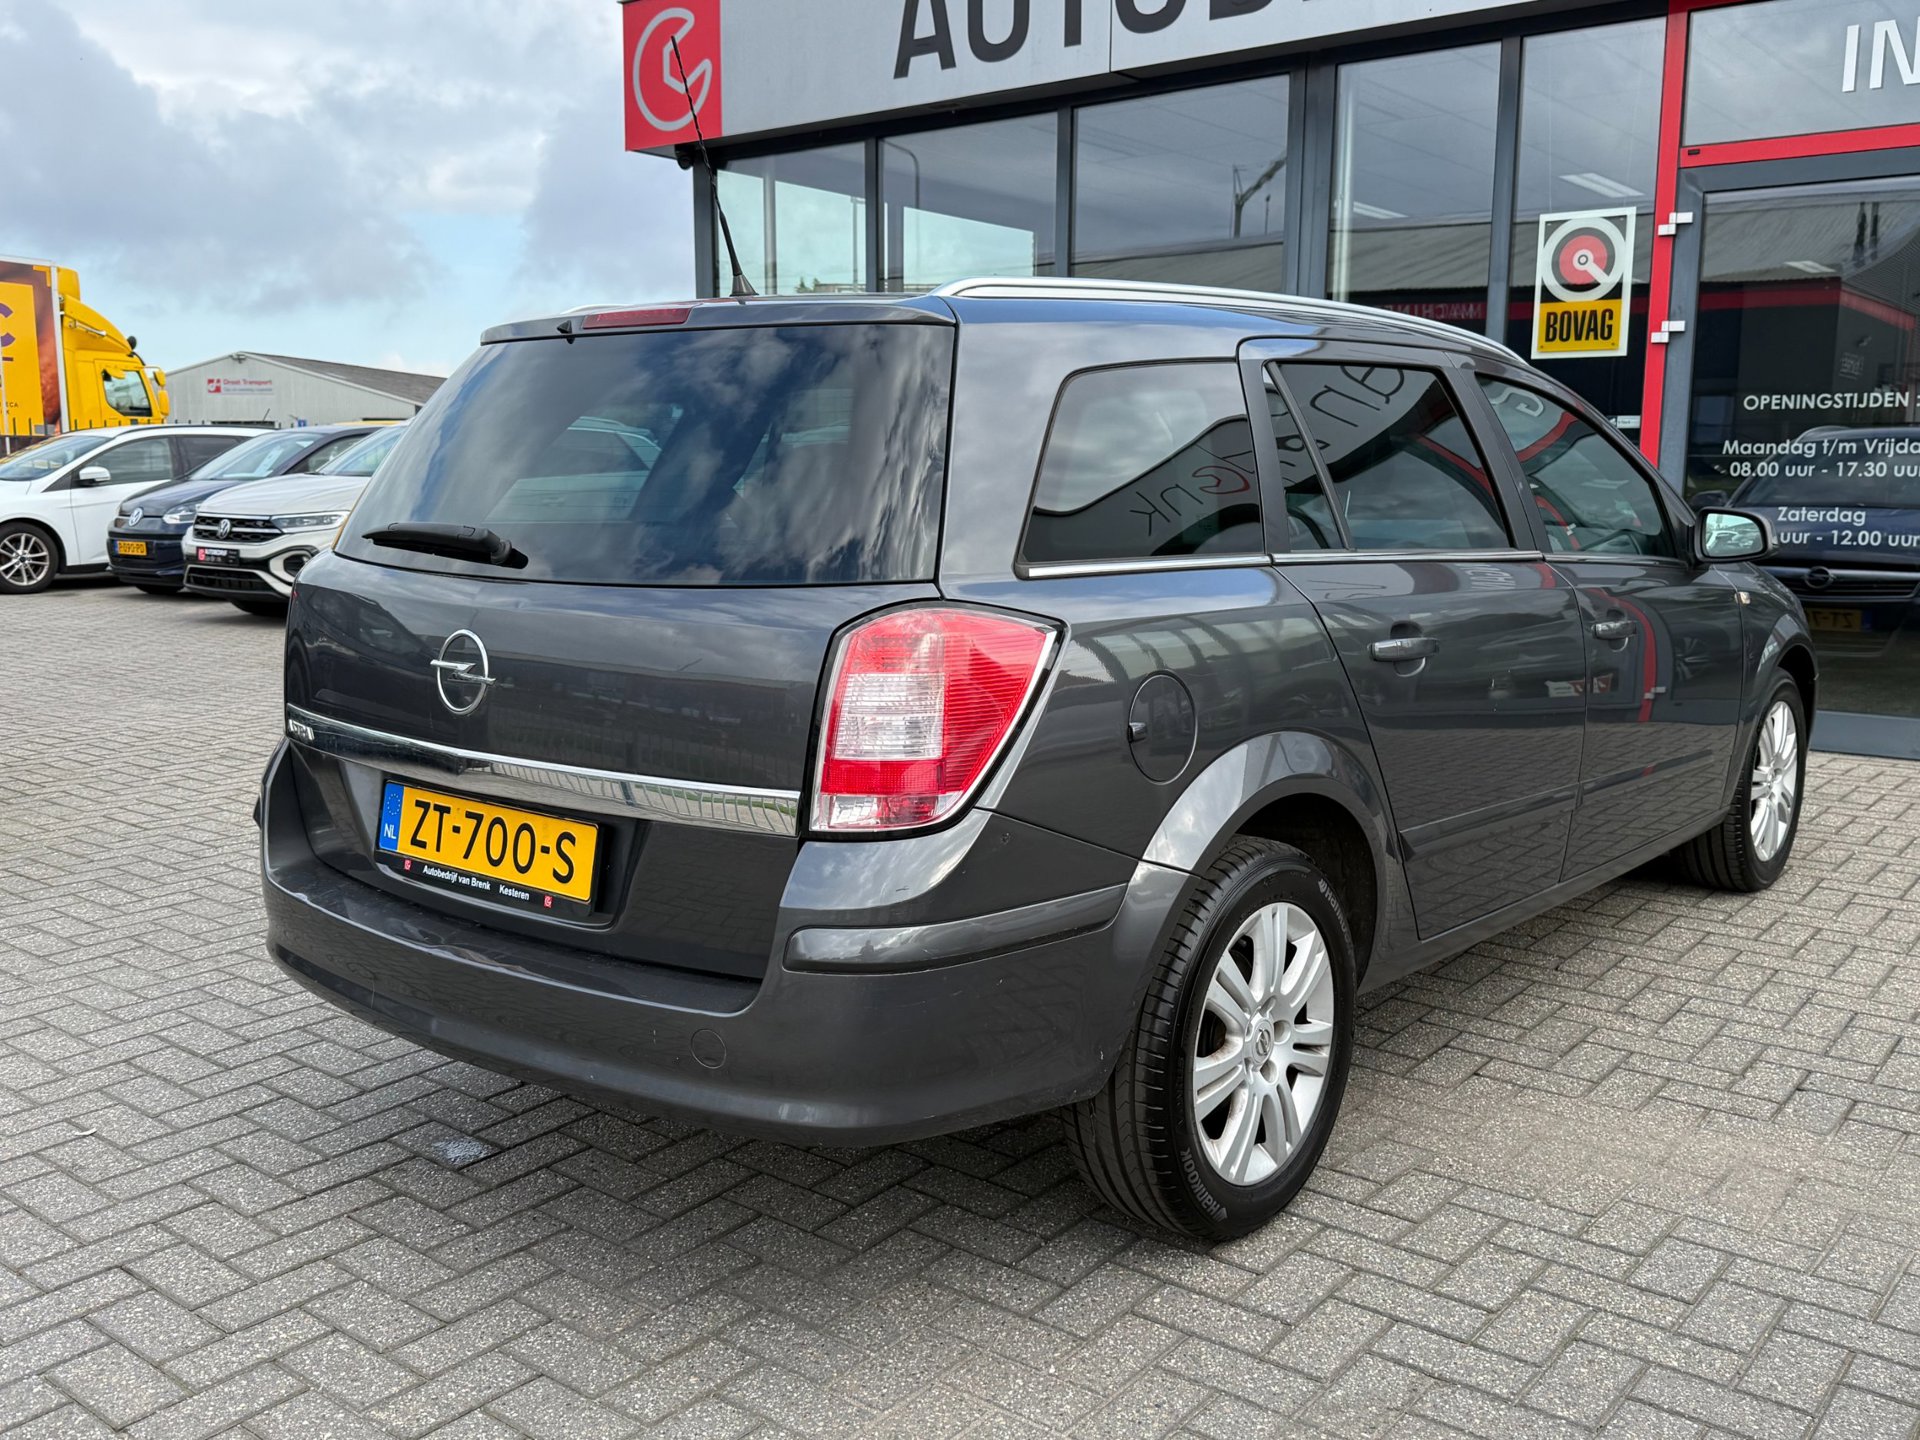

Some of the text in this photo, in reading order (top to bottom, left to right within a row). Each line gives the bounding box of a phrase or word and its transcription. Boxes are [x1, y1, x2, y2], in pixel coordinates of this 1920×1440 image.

[1545, 308, 1614, 343] BOVAG
[1743, 391, 1910, 411] OPENINGSTIJDEN
[1722, 439, 1817, 457] Maandag
[1823, 438, 1857, 455] t/m
[1729, 461, 1779, 477] 08.00
[1785, 464, 1816, 477] uur
[1836, 461, 1887, 477] 17.30
[1893, 464, 1920, 477] uu
[1777, 506, 1866, 525] Zaterdag
[1780, 532, 1810, 544] uur
[1831, 530, 1882, 546] 12.00
[1888, 534, 1920, 547] uur
[384, 822, 397, 840] NL
[410, 799, 577, 885] ZT-700-S
[422, 864, 530, 901] Autobedrijf van Brenk Kesteren
